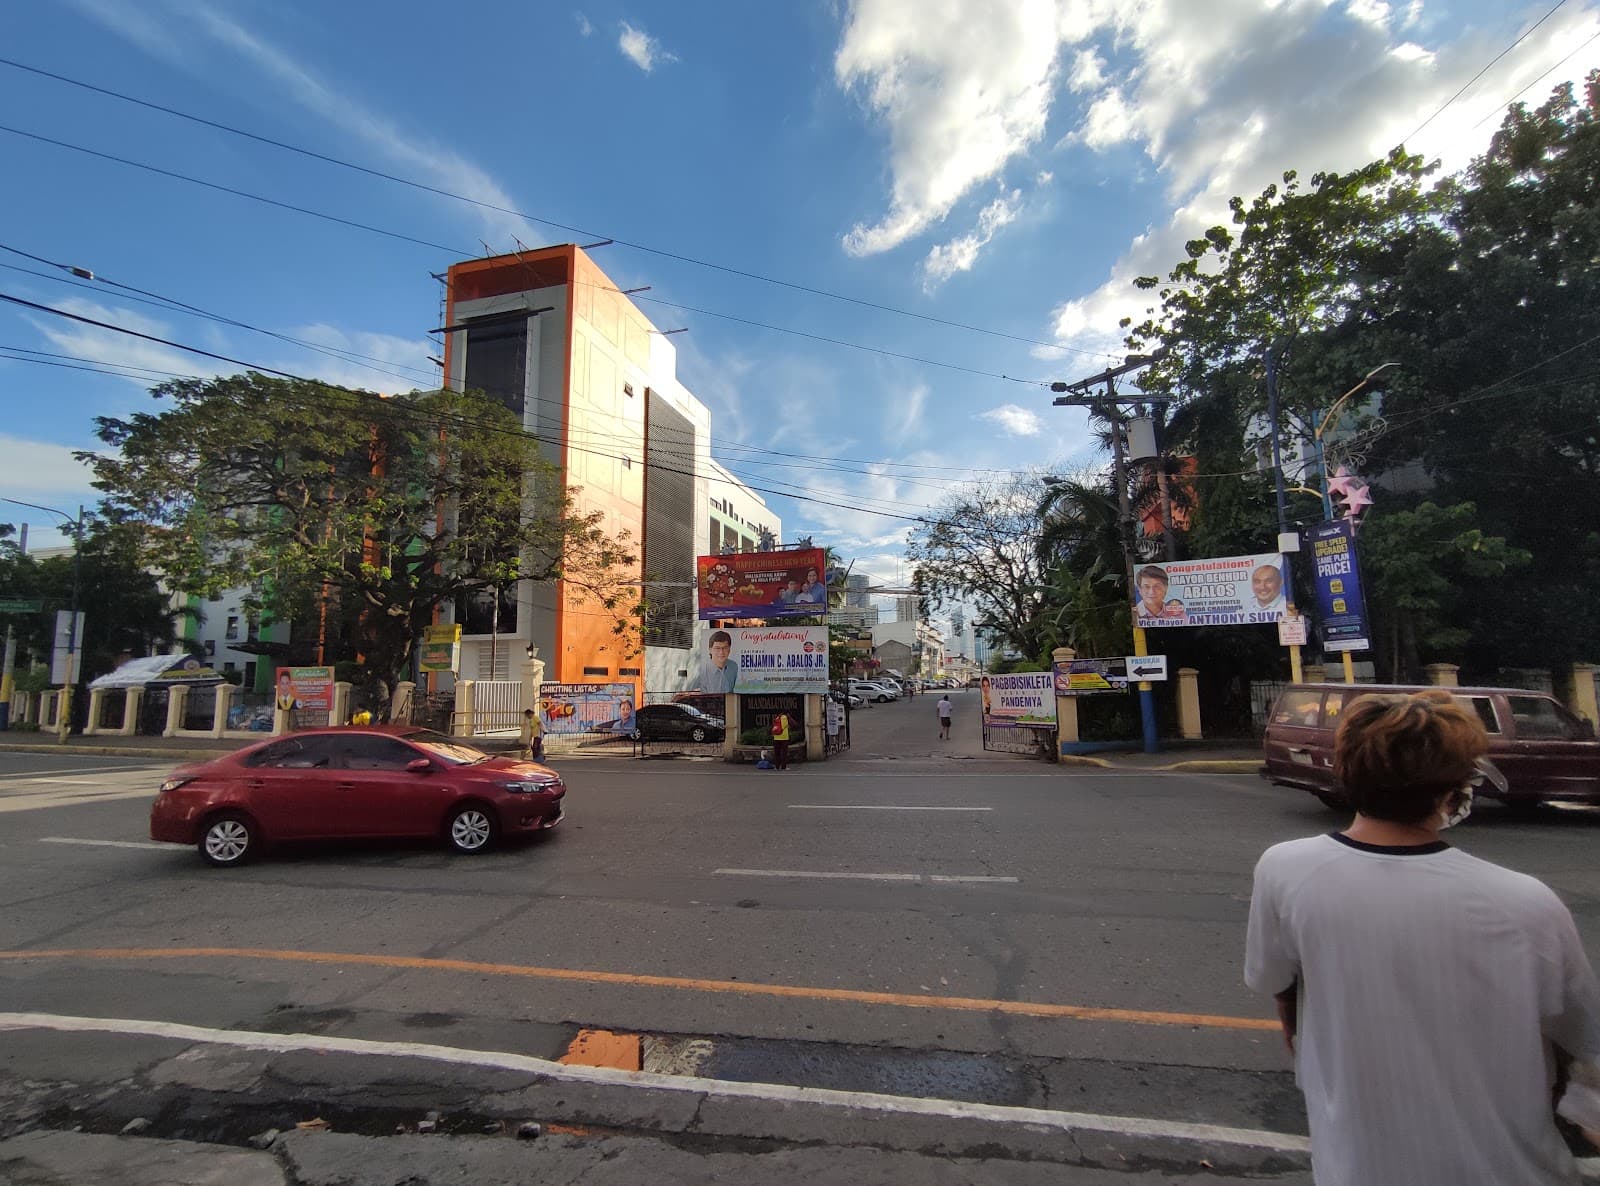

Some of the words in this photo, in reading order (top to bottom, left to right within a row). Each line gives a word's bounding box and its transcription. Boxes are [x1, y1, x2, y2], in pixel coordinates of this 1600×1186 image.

[1166, 560, 1254, 574] Congratulations!
[1318, 560, 1351, 577] PRICE!
[1170, 574, 1203, 585] MAYOR
[1206, 571, 1248, 582] BENHUR
[1183, 583, 1235, 599] ABALOS
[1158, 619, 1184, 627] Mayor
[1189, 614, 1245, 625] ANTHONY
[740, 630, 808, 644] Congratulations!
[741, 654, 775, 668] BENJAMIN
[777, 654, 784, 668] C.
[787, 654, 812, 668] ABALOS
[815, 654, 826, 668] JR.
[541, 685, 573, 693] CHIKITING
[991, 676, 1052, 690] PAGBIBISIKLETA
[1001, 697, 1042, 707] PANDEMYA
